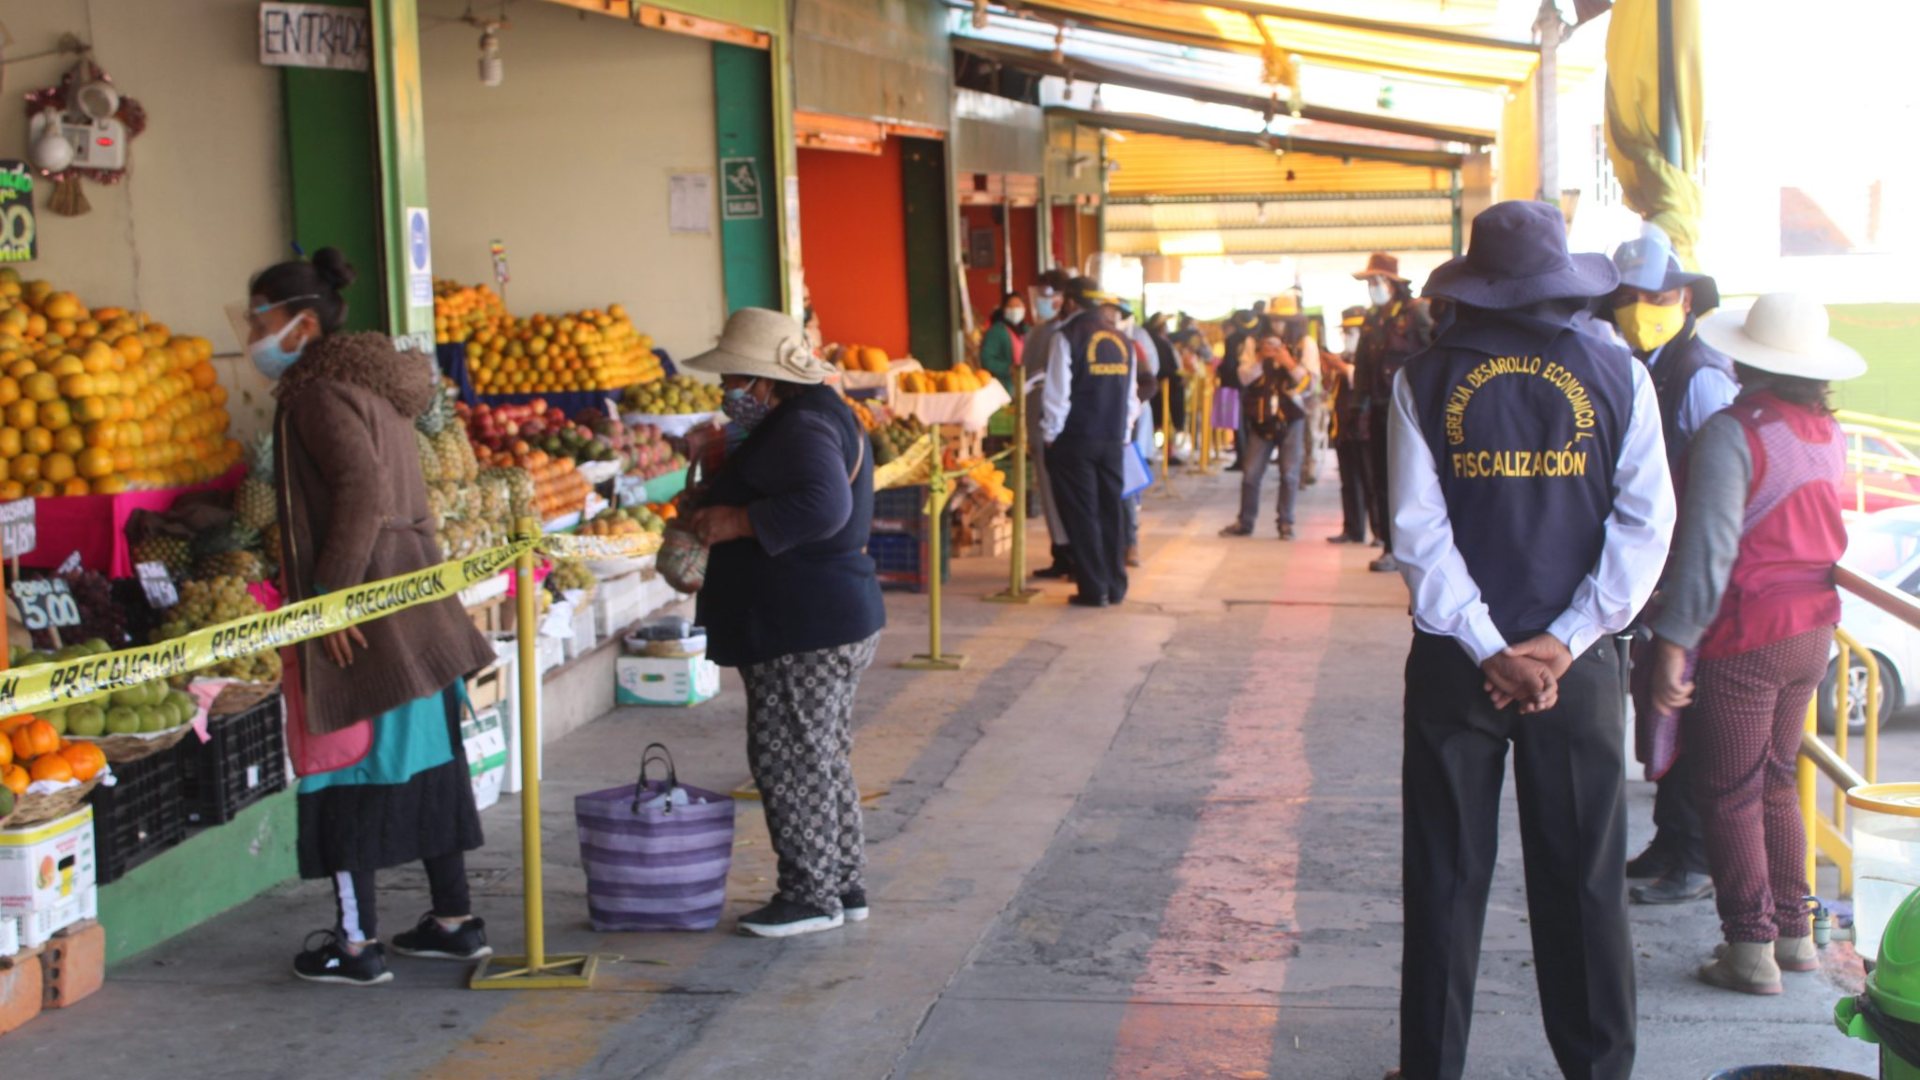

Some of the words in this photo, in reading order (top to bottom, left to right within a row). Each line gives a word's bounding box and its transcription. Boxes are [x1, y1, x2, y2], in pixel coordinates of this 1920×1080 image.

[1445, 385, 1475, 445] GERENCIA
[1465, 356, 1542, 389] DESAROLLO
[1541, 361, 1595, 429] ECONOMICO
[1452, 440, 1587, 478] FISCALIZACIÓN
